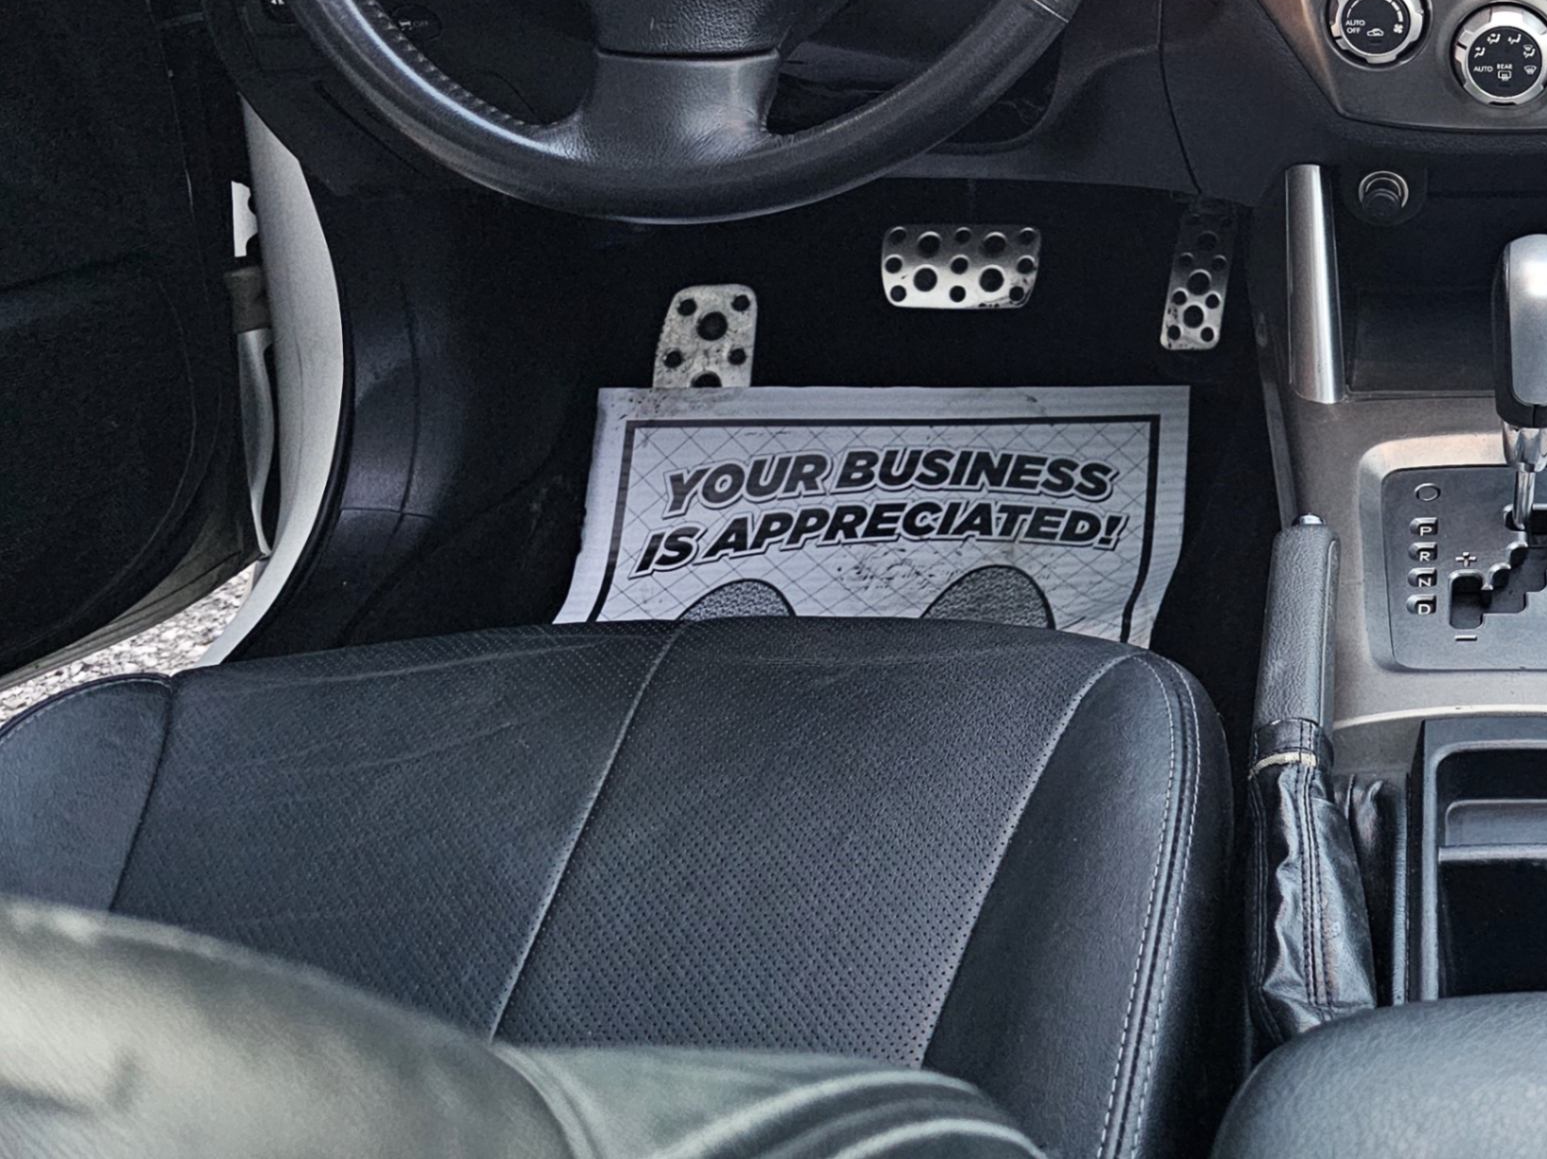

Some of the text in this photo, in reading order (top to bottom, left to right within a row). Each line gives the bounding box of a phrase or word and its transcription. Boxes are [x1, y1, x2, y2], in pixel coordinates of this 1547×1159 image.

[664, 448, 1117, 515] YOUR BUSINESS
[633, 500, 1127, 574] IS APPRECIATED!
[1419, 526, 1432, 536] P
[1419, 551, 1431, 562] R
[1418, 576, 1432, 588] N
[1417, 603, 1431, 615] D
